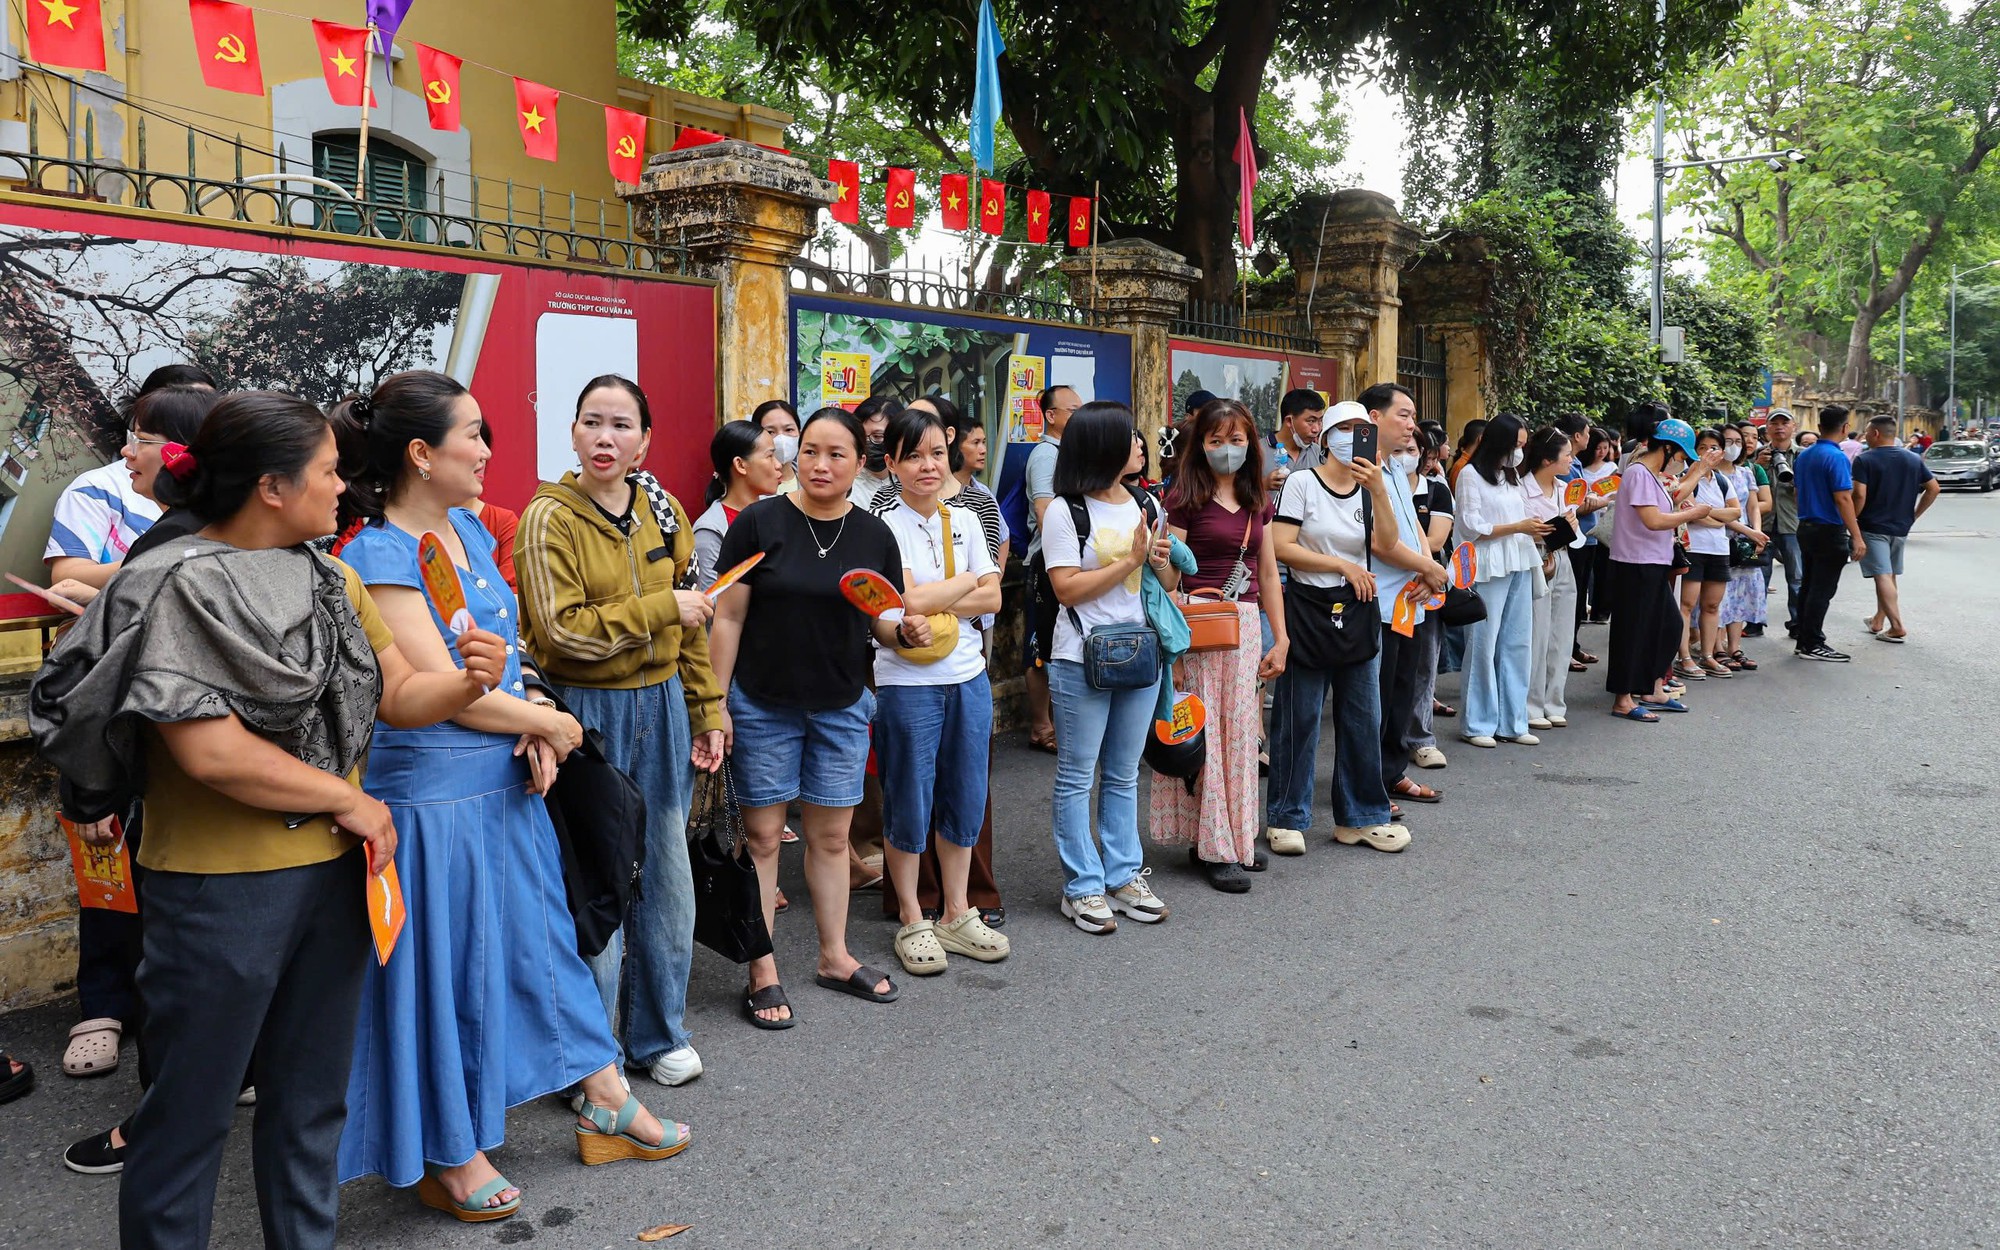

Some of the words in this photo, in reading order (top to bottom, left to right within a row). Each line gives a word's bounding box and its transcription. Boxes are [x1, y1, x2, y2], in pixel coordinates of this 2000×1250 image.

[547, 300, 577, 310] TRƯỜNG
[577, 303, 594, 312] THPT
[594, 305, 609, 313] CHU
[609, 305, 623, 315] VĂN
[623, 308, 633, 316] AN
[574, 293, 584, 301] DỤC
[842, 366, 856, 393] 10
[1024, 368, 1034, 390] 10
[1170, 713, 1194, 735] FPT
[83, 856, 124, 882] FPT
